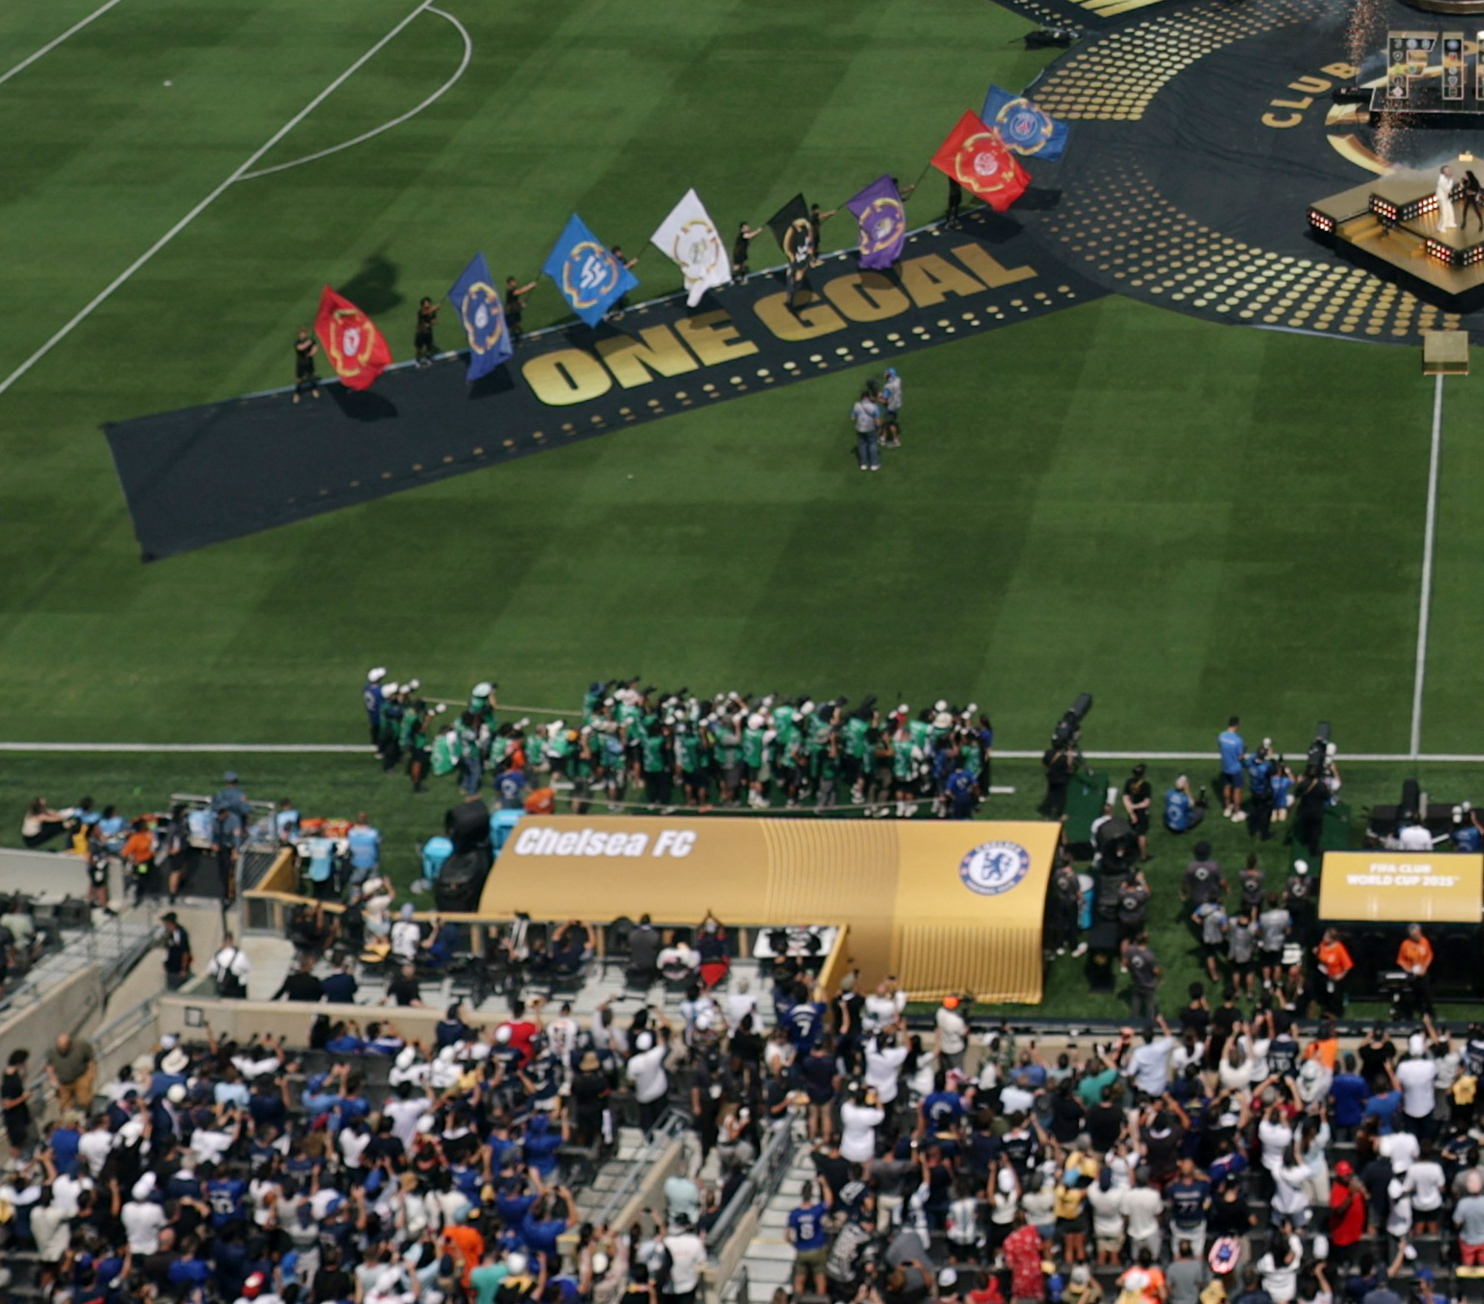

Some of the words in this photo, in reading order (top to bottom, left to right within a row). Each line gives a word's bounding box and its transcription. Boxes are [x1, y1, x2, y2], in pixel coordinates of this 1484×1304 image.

[1260, 62, 1359, 129] CLUB
[521, 309, 760, 407] ONE
[753, 241, 1038, 343] GOAL
[514, 826, 650, 858] Chelsea
[652, 829, 697, 859] FC
[1346, 874, 1393, 886] WORLD
[1394, 875, 1421, 886] CUP
[1369, 863, 1397, 873] FIFA
[1398, 864, 1432, 874] CLUB
